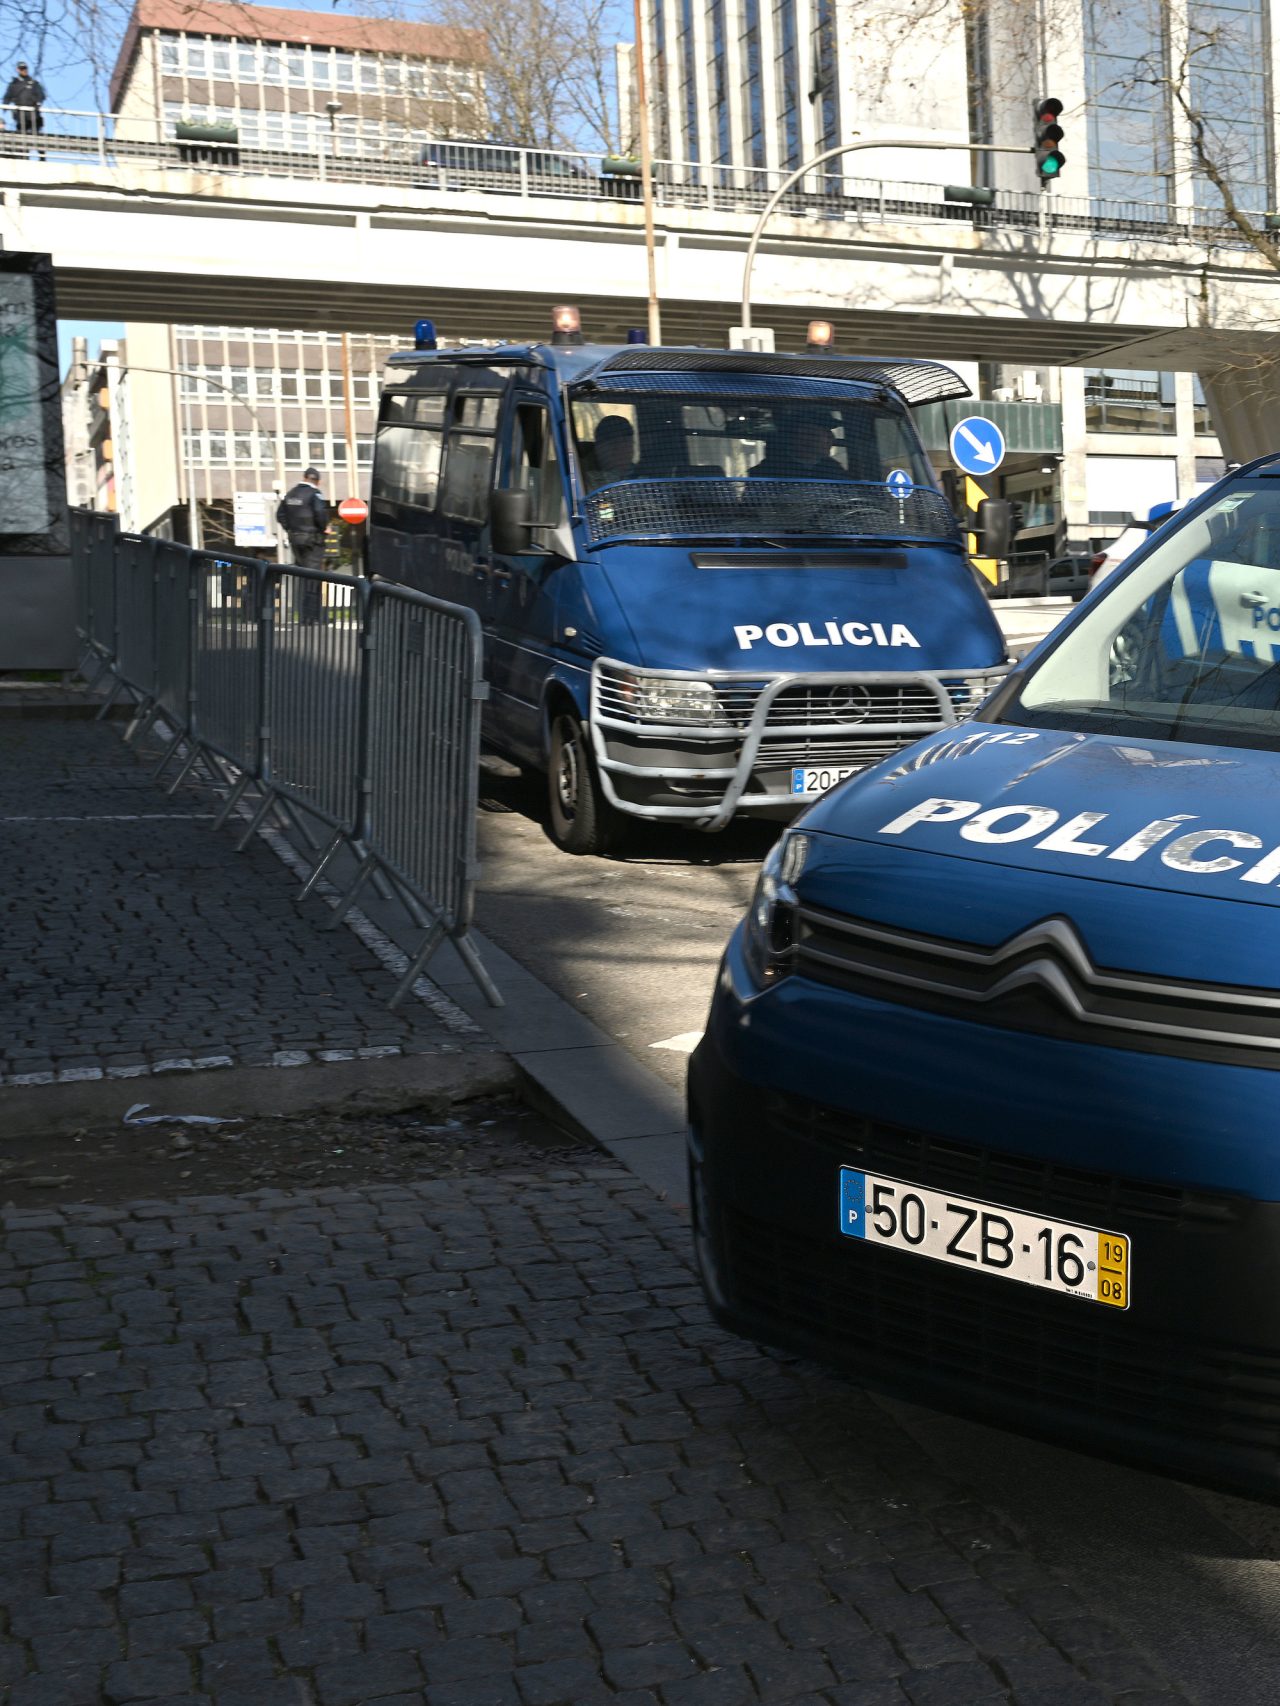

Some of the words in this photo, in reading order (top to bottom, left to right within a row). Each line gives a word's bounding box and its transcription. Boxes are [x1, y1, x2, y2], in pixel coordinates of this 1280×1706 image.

[960, 731, 1041, 745] 112
[848, 1209, 858, 1224] P
[1104, 1241, 1123, 1263] 19
[1101, 1279, 1122, 1300] 08
